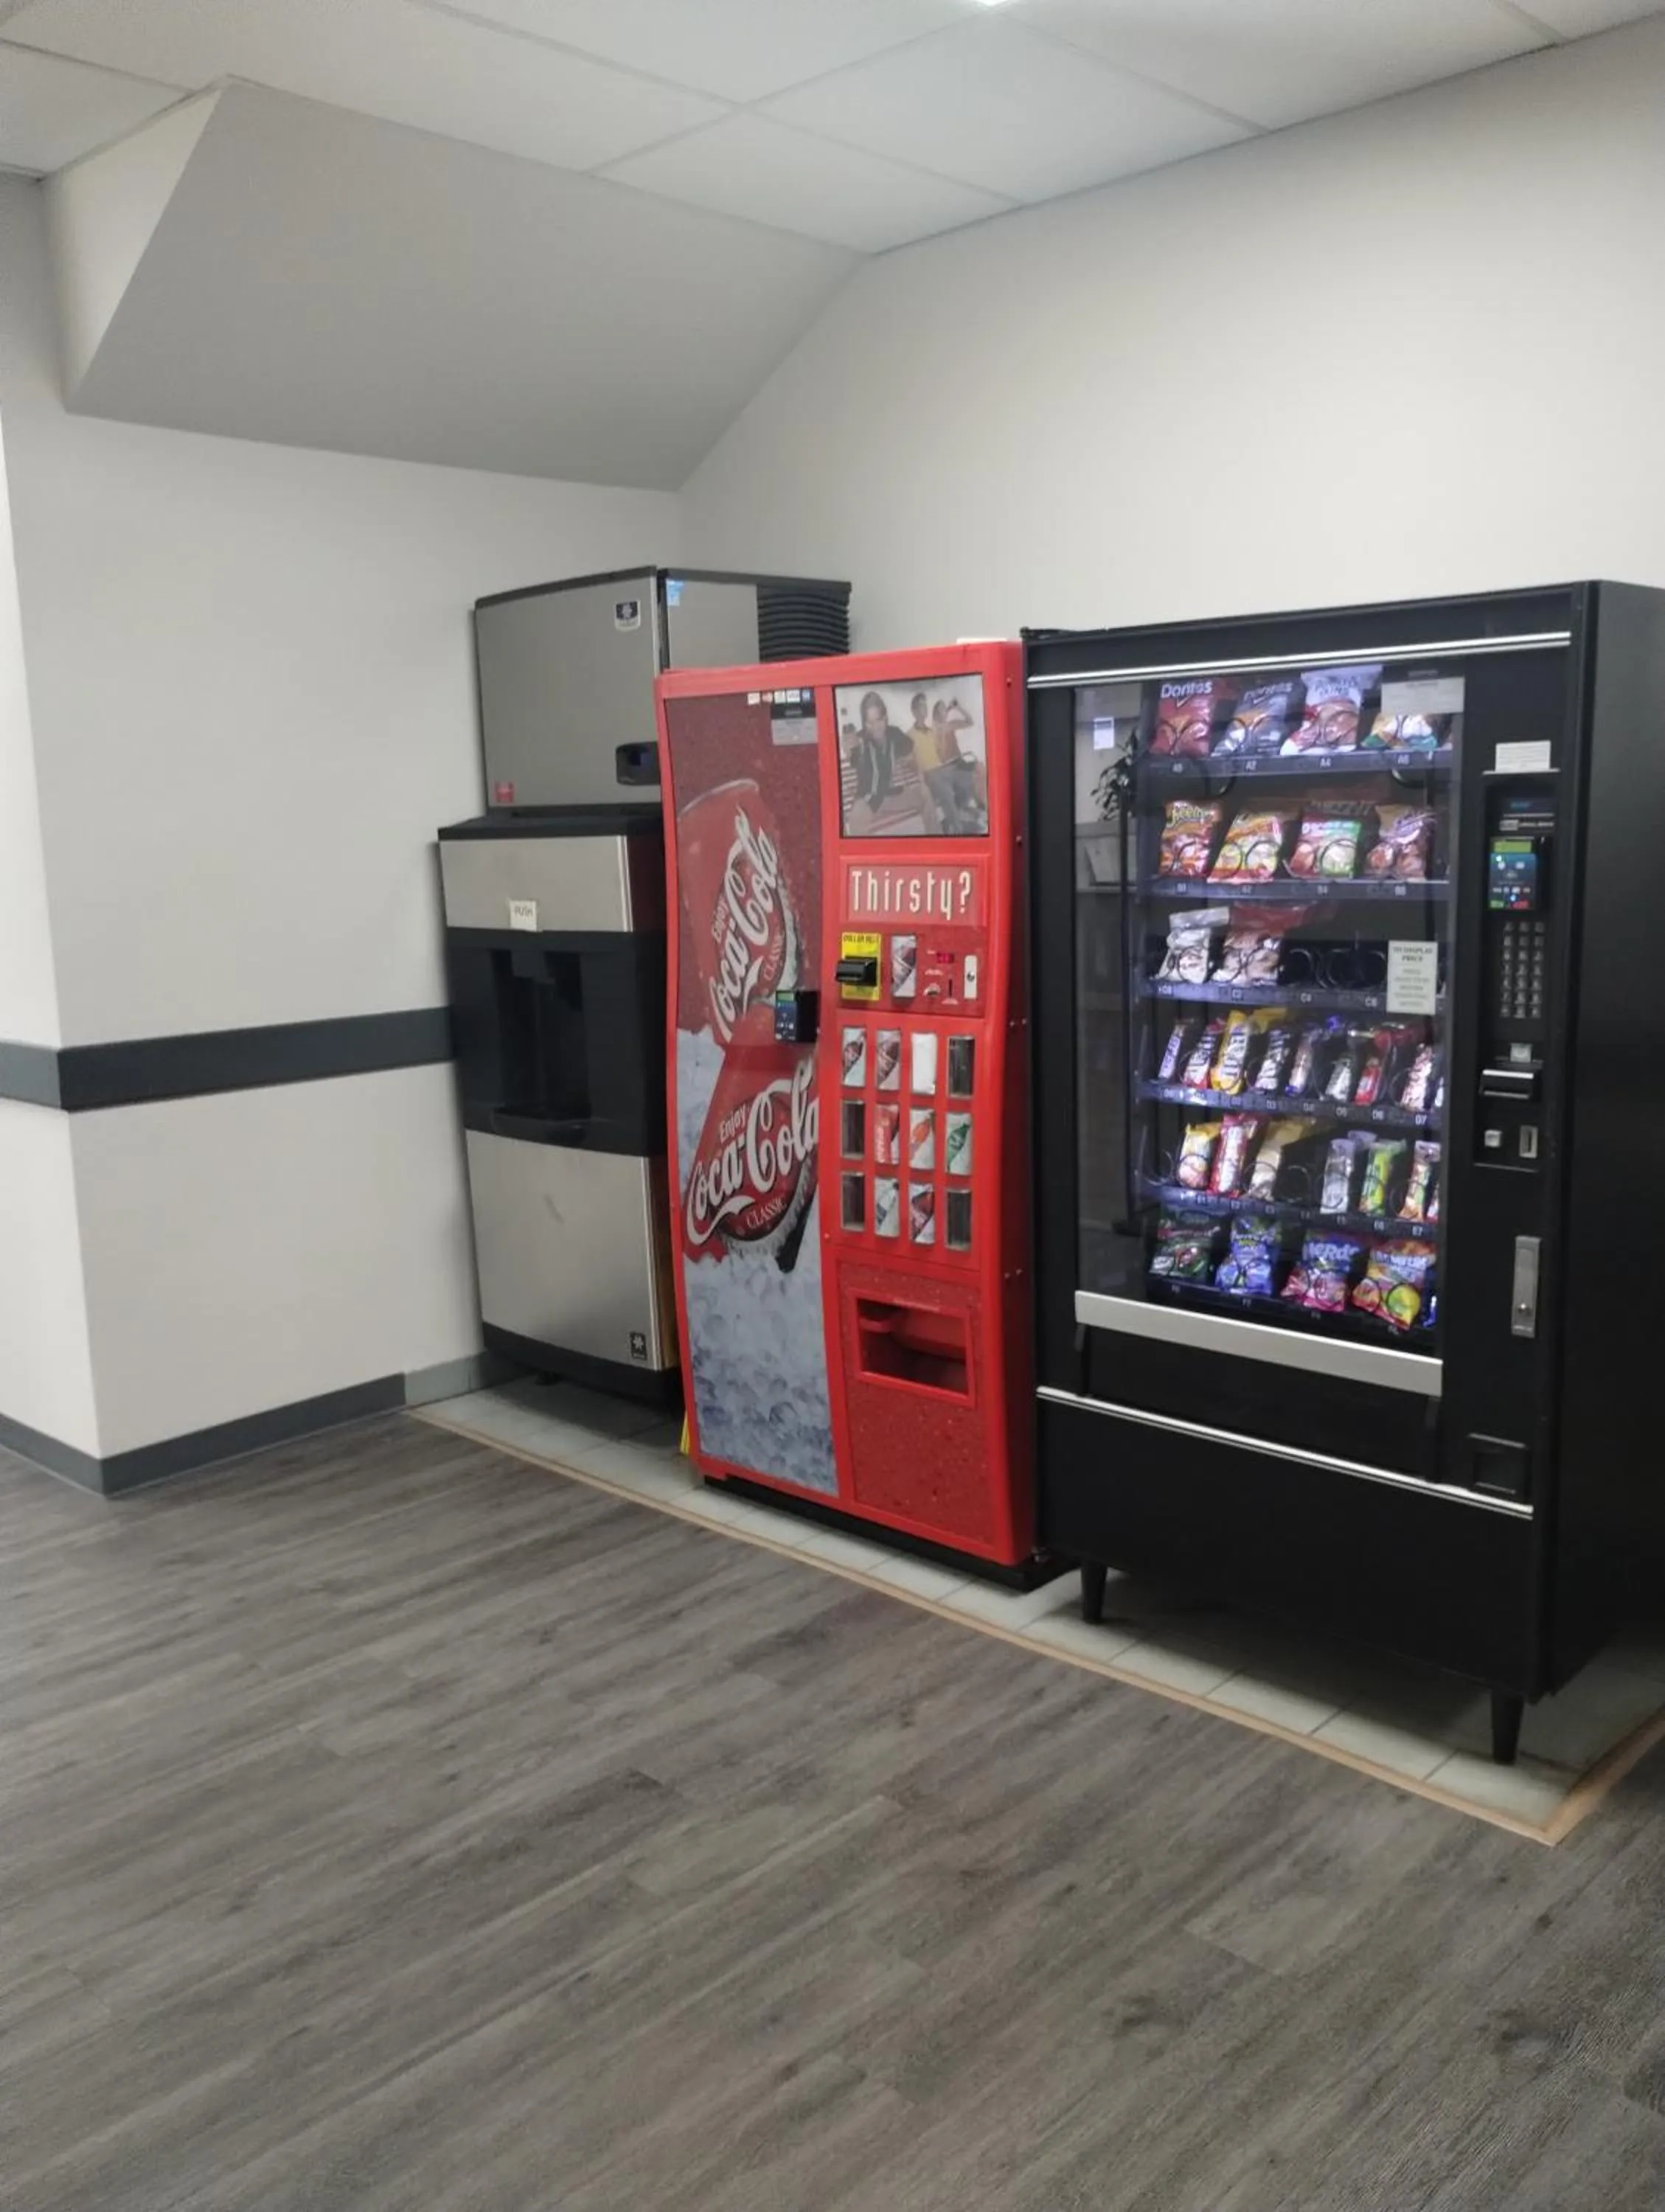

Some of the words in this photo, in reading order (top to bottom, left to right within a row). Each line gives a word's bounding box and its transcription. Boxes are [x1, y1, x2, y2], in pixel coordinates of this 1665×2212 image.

[1161, 681, 1213, 698] Doritos
[852, 870, 971, 921] Thirsty?
[709, 804, 777, 1043] Coca-Cola
[719, 1104, 747, 1143] Enjoy
[686, 1056, 818, 1245] Coca-Cola
[746, 1194, 788, 1228] CLASSIC
